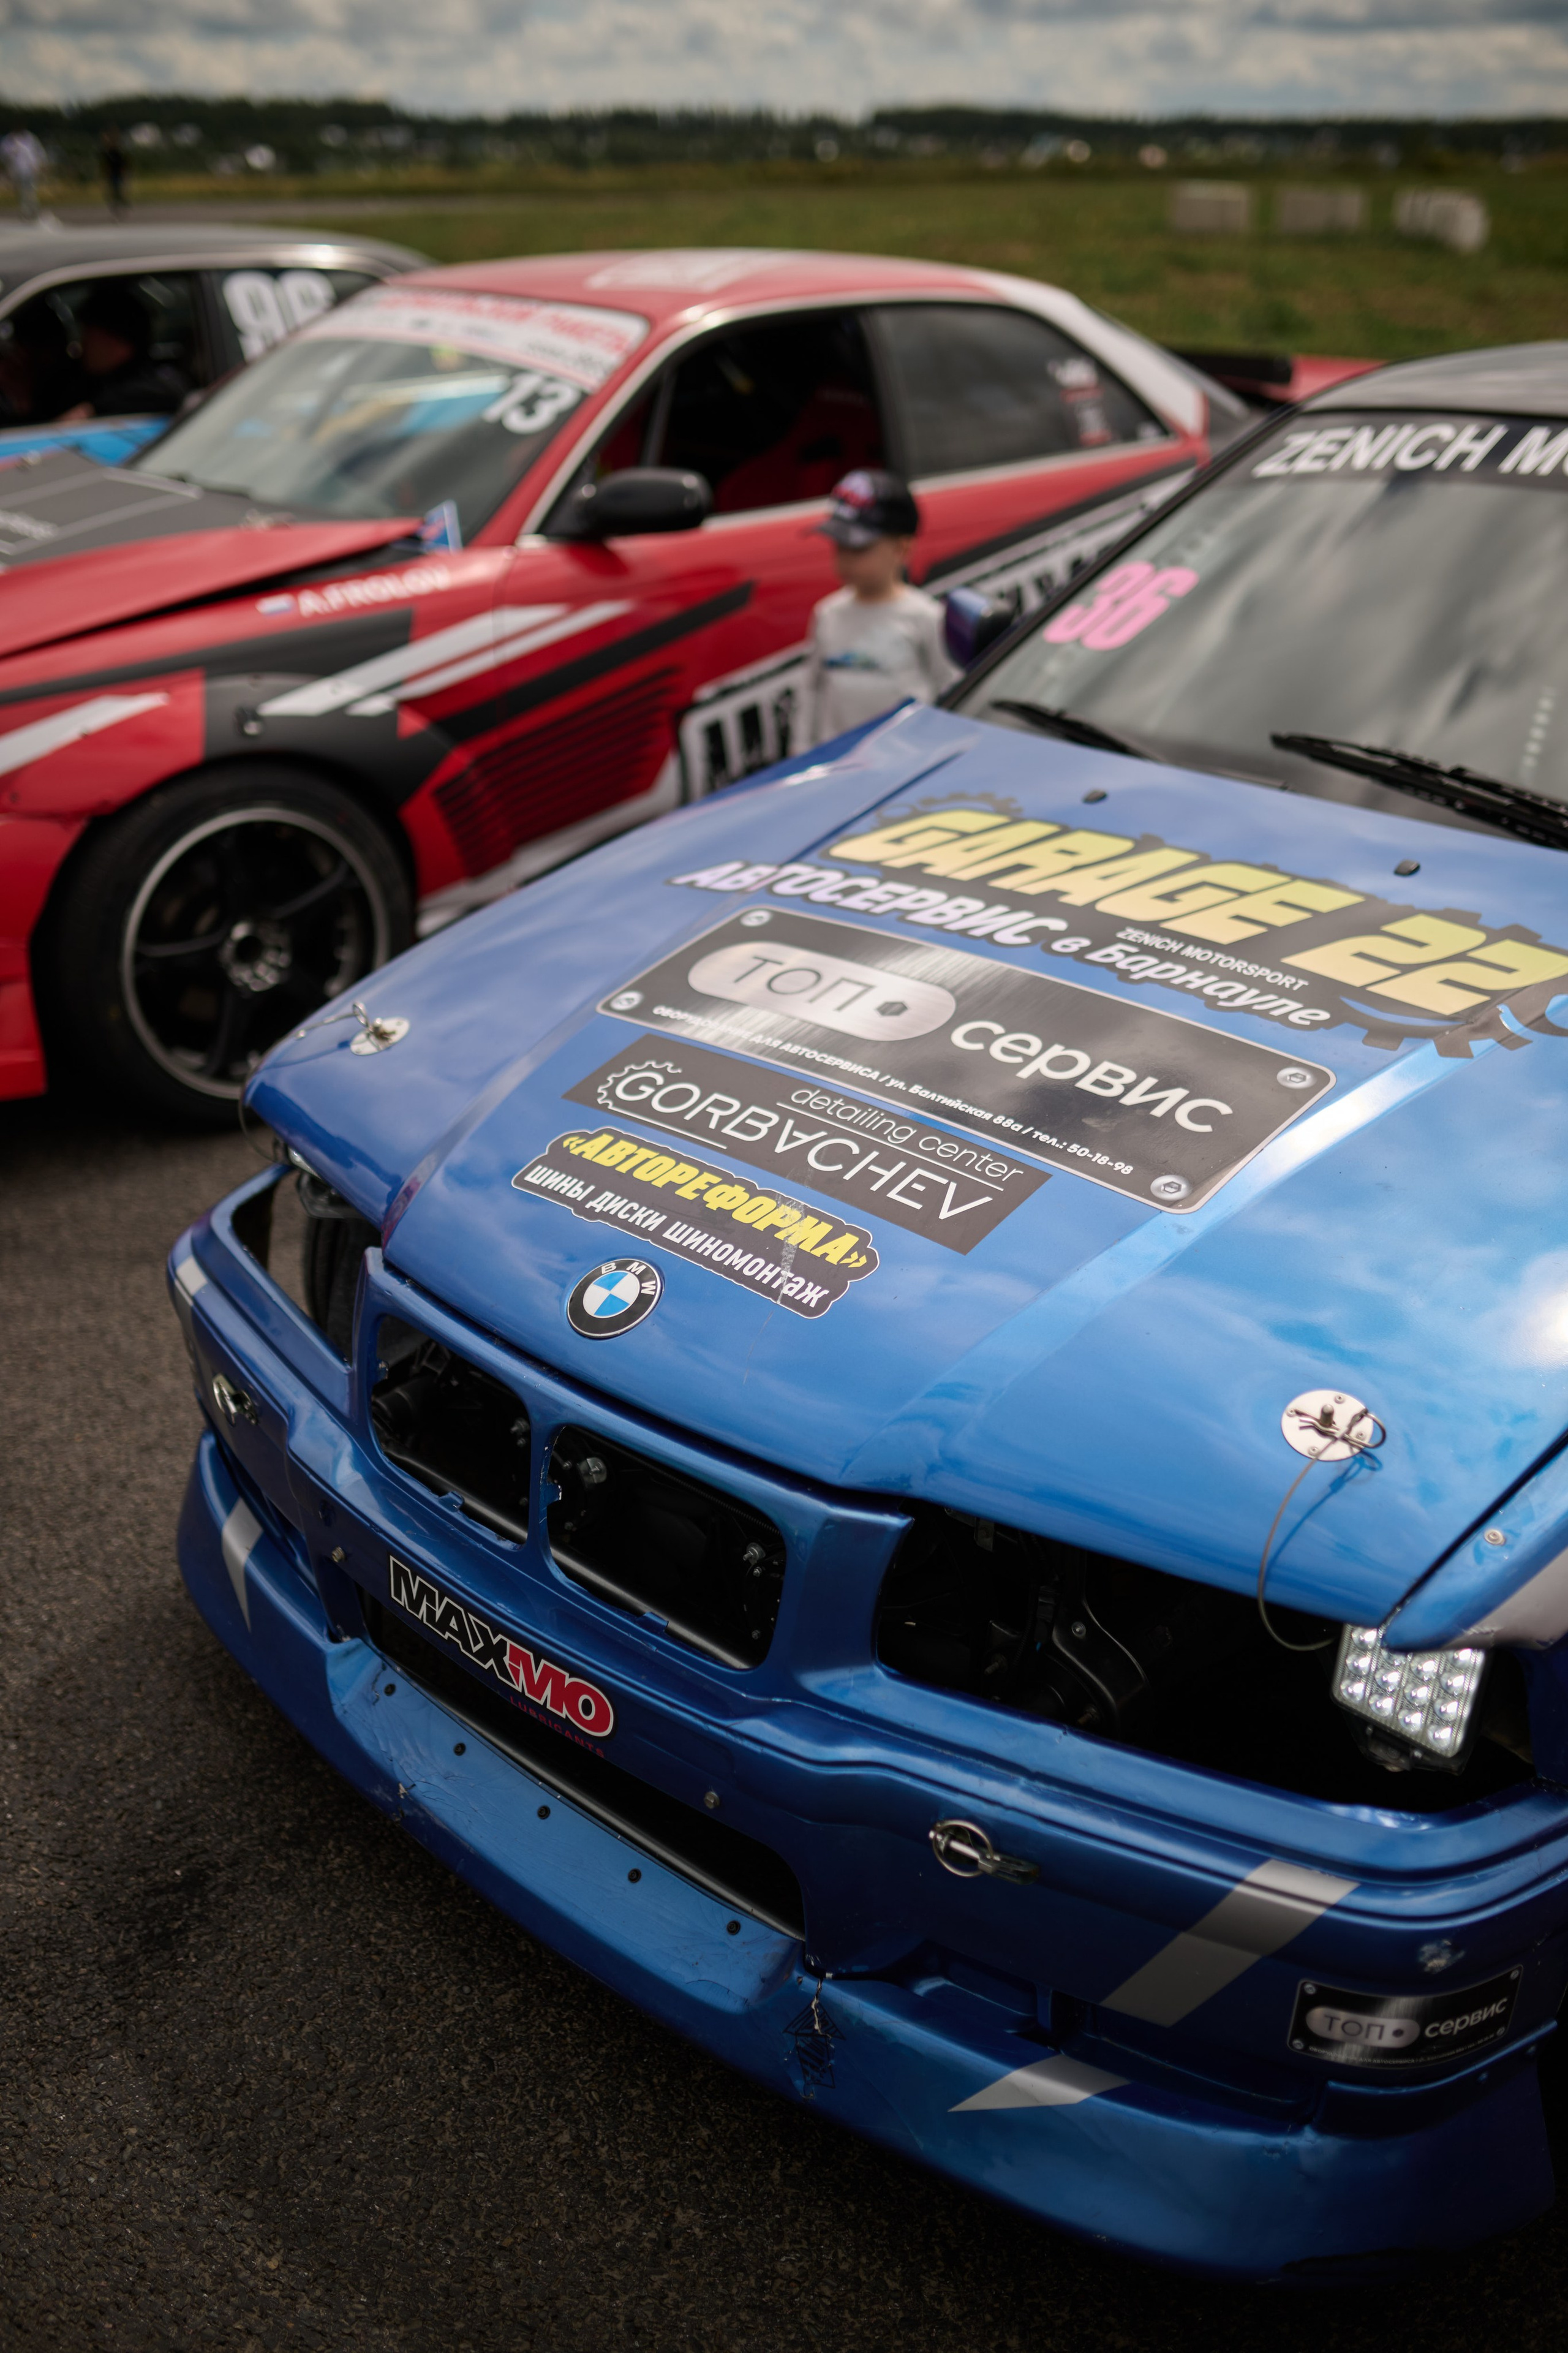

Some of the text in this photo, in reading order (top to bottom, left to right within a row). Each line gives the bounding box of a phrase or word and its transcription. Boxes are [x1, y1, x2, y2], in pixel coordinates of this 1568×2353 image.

[482, 371, 582, 434] 13
[1251, 423, 1568, 478] ZENICH M
[1043, 561, 1199, 651] 36
[673, 861, 1068, 945] АВТОСЕРВИС
[1085, 942, 1330, 1025] Барнауле
[829, 809, 1568, 1016] GARAGE 22
[1115, 927, 1309, 991] ZENICH MOTORSPORT
[749, 1033, 785, 1048] ДЛЯ
[778, 1040, 881, 1081] АВТОСЕРВИСА
[885, 1078, 908, 1090] ул.
[908, 1084, 993, 1120] Балтийская
[1066, 1143, 1134, 1175] 50-18-98
[951, 1020, 1233, 1133] сервис
[791, 1088, 1023, 1182] detailing center
[563, 1133, 867, 1268] «АВТОРЕФОРМА»
[601, 1261, 657, 1296] BMW
[510, 1696, 605, 1758] LUBRICANTS
[1425, 1998, 1508, 2038] сервис
